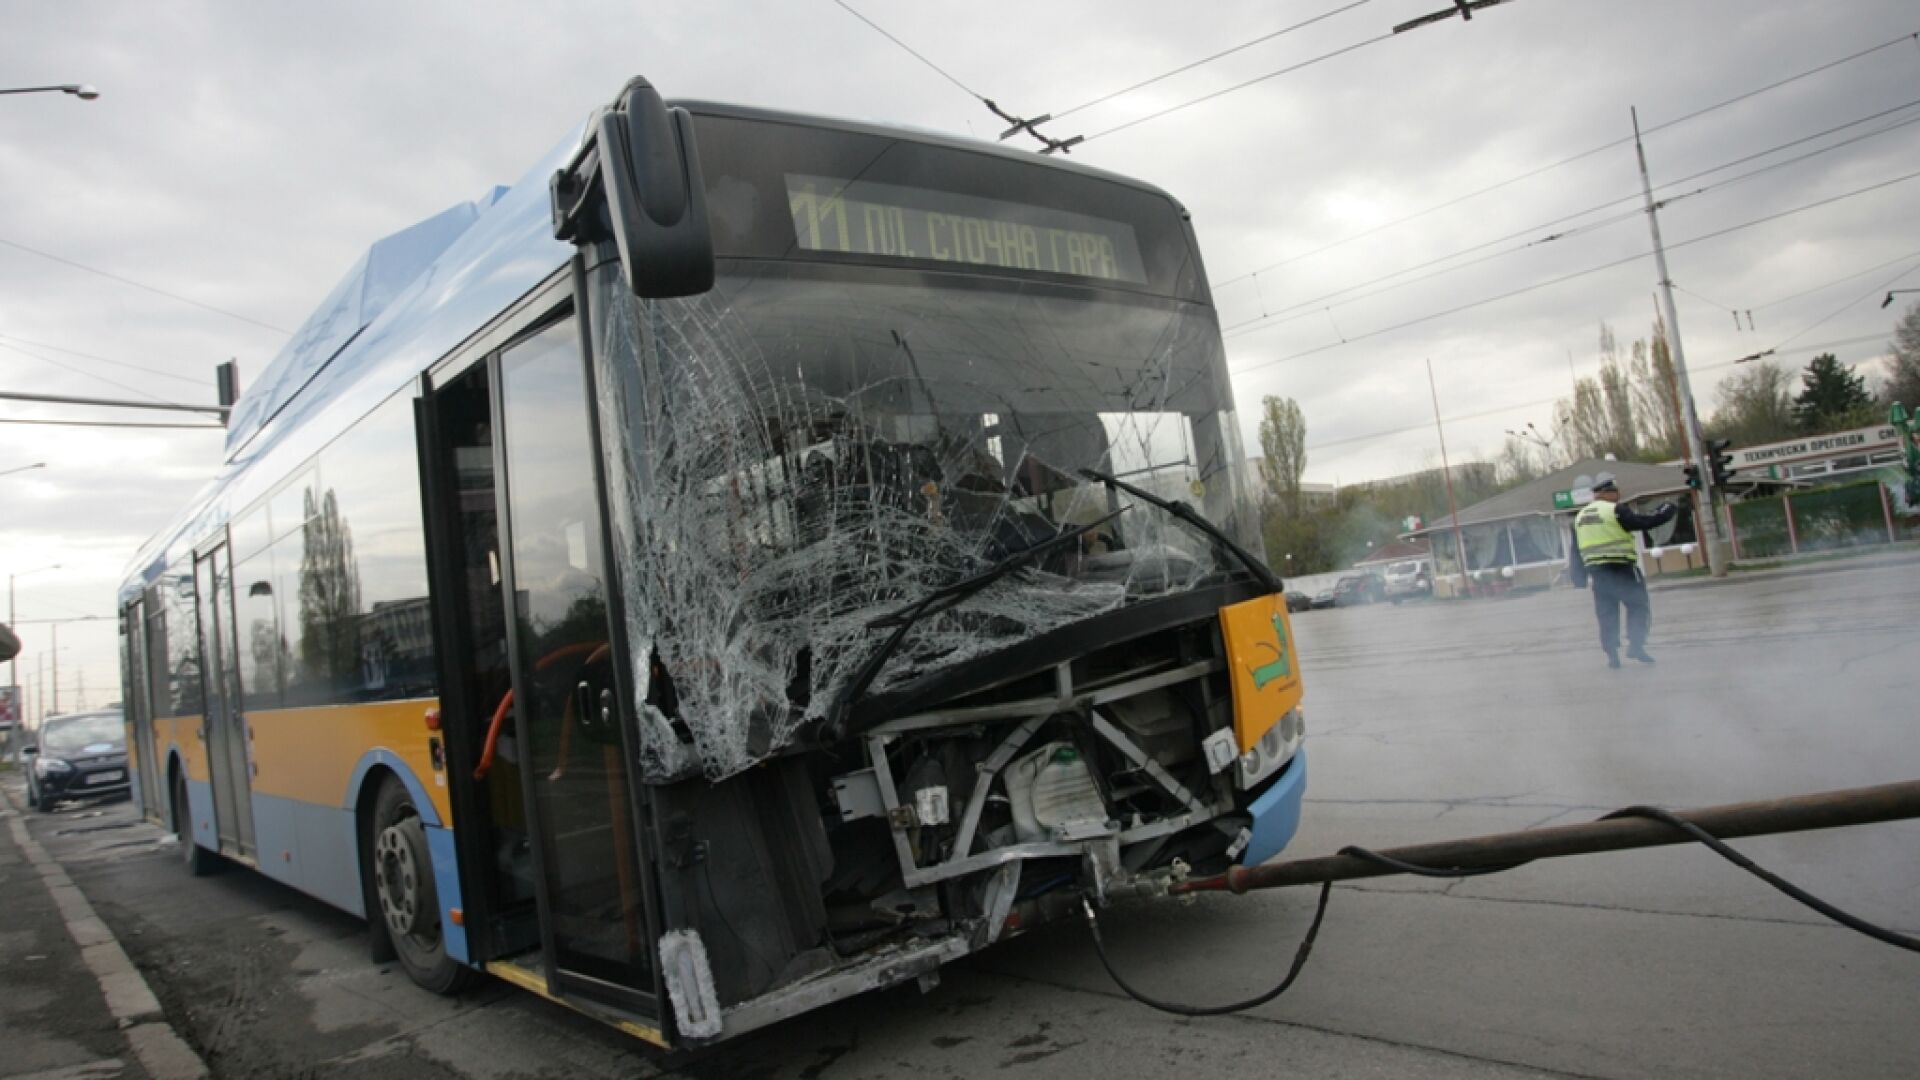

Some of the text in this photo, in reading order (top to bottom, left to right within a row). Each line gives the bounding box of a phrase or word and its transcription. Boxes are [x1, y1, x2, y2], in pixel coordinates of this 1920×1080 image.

[789, 184, 850, 252] 11
[928, 211, 1040, 272] СТОЧНА
[1050, 228, 1120, 280] ГАРА
